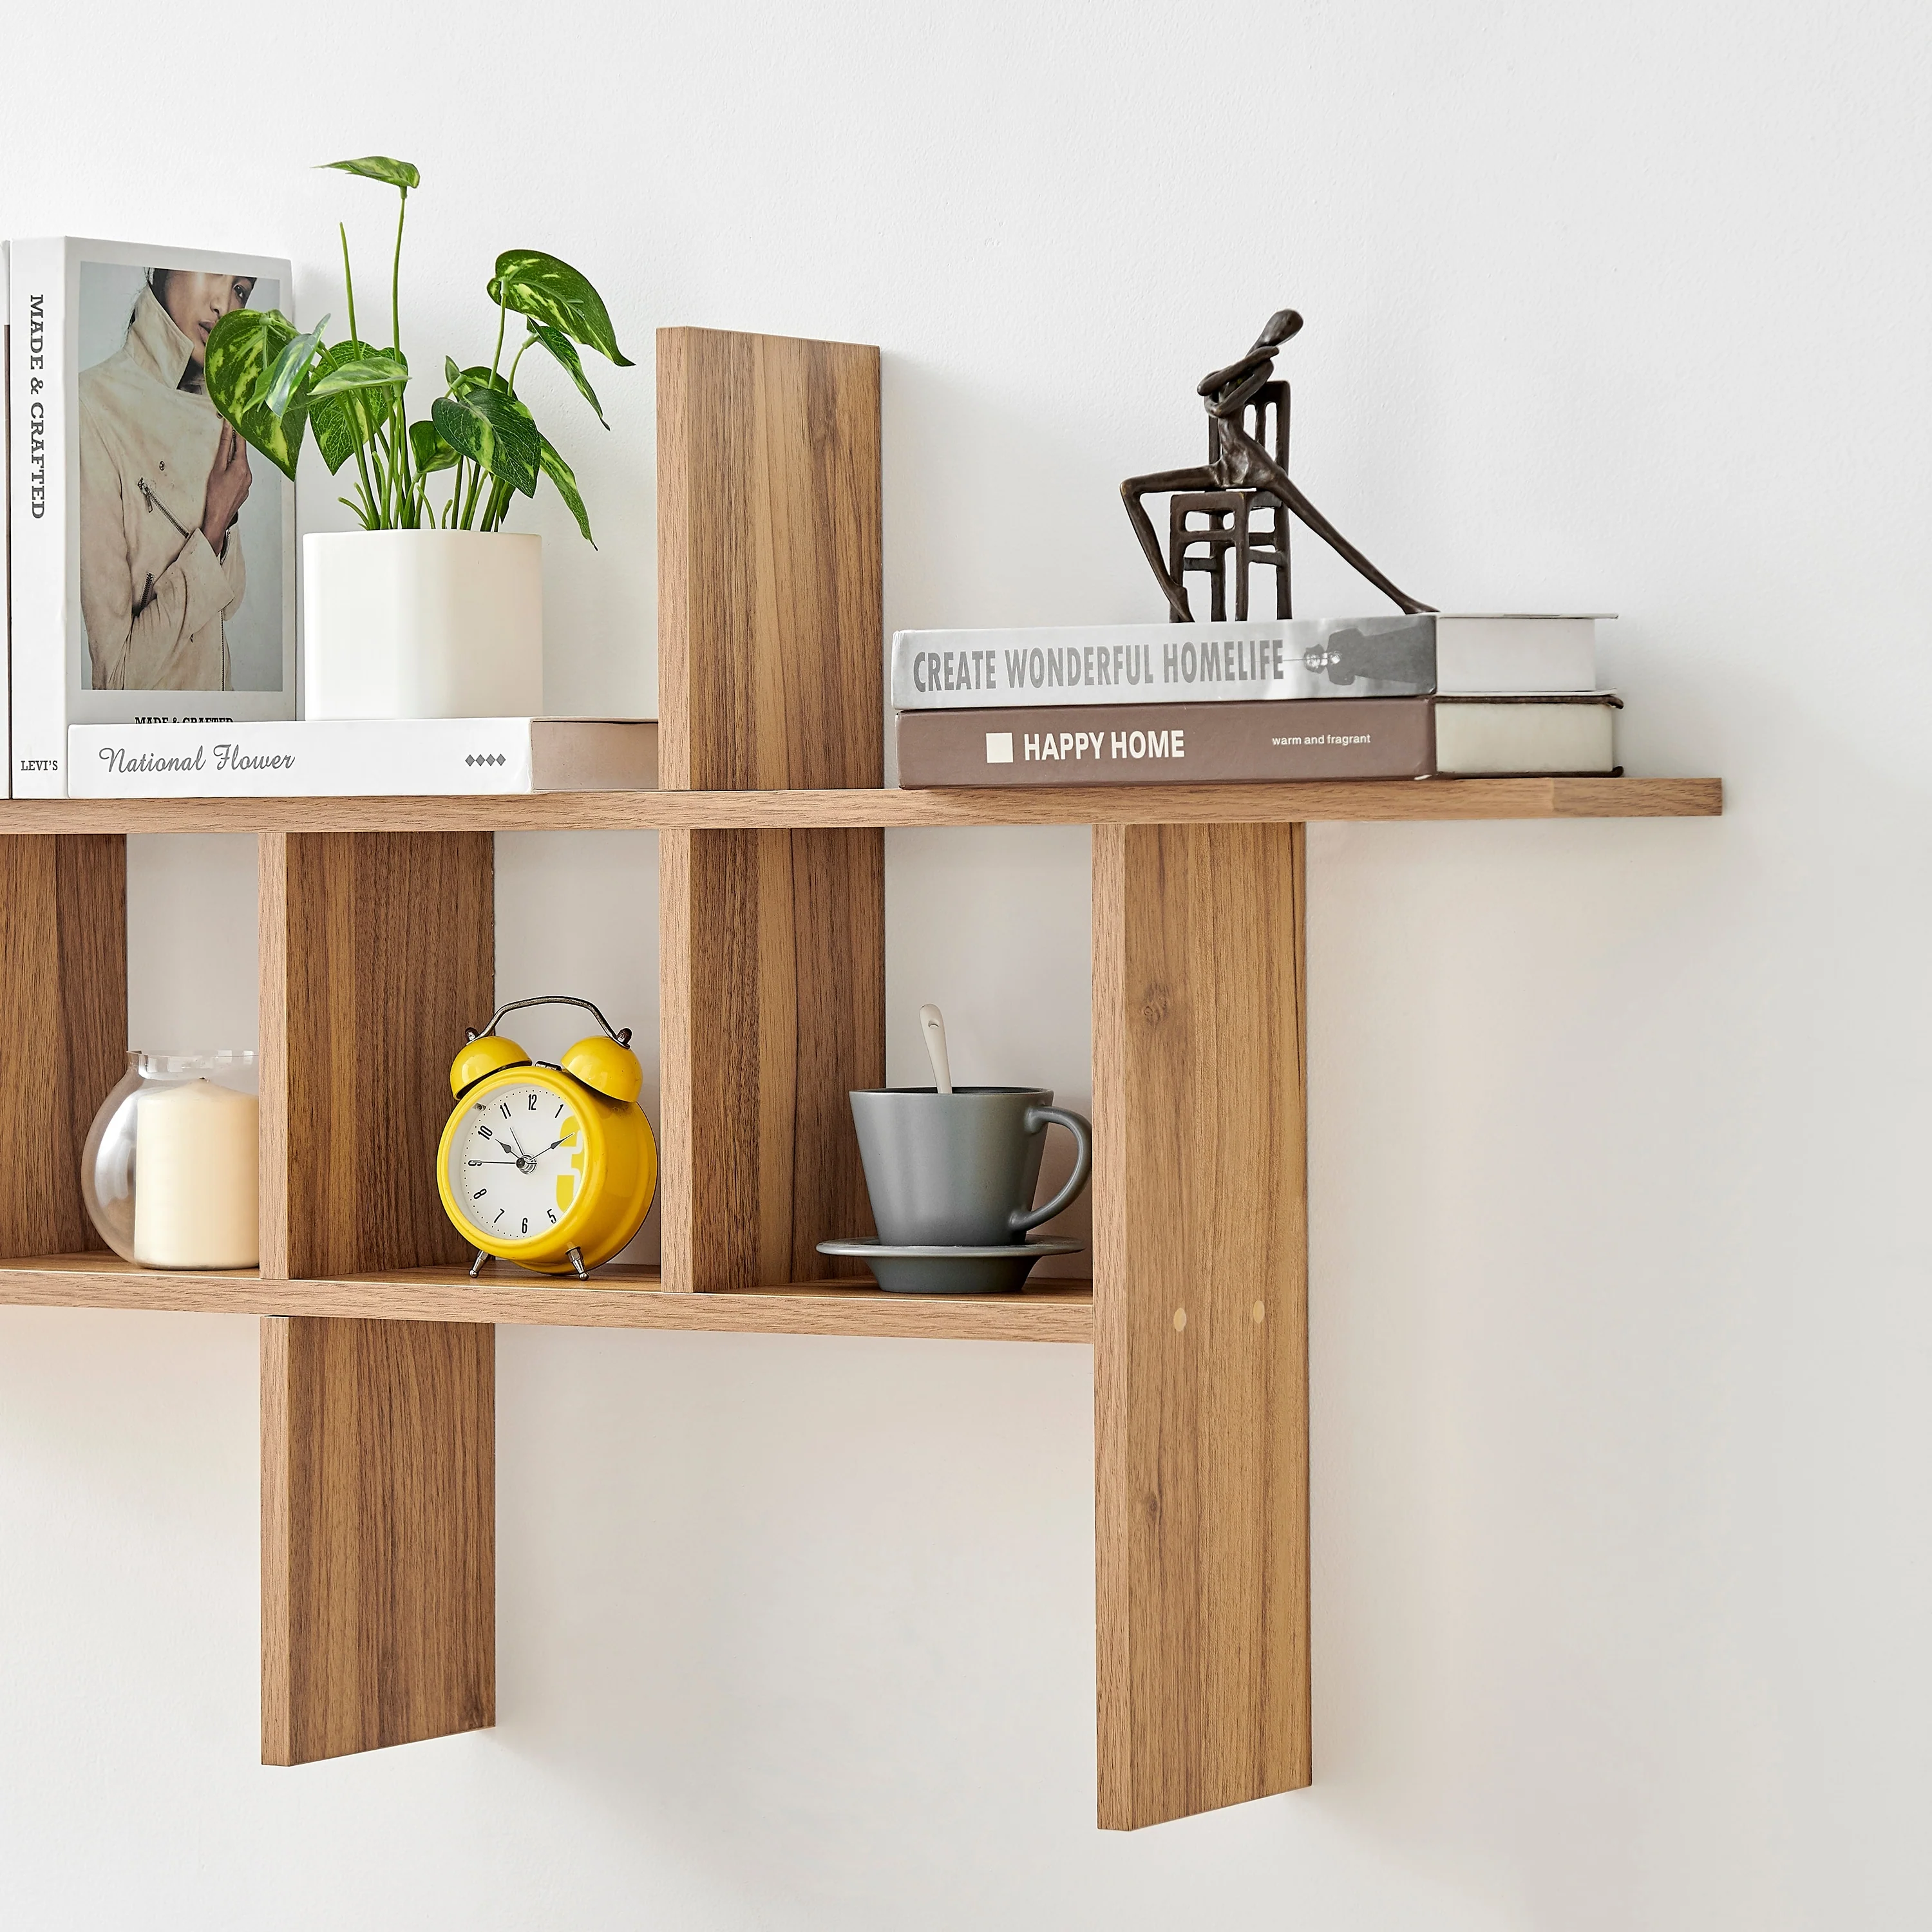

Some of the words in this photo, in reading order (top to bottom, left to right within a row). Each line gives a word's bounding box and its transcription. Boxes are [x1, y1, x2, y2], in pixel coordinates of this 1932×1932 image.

[30, 294, 44, 370] MADE
[30, 377, 44, 395] &
[30, 402, 45, 519] CRAFTED
[913, 650, 996, 693] CREATE
[1005, 645, 1153, 688] WONDERFUL
[1164, 639, 1283, 683] HOMELIFE
[1024, 732, 1104, 761] HAPPY
[1111, 730, 1185, 759] HOME
[1272, 737, 1302, 745] warm
[1304, 734, 1325, 745] and
[1327, 734, 1371, 746] fragrant
[21, 760, 58, 771] LEVI'S
[99, 744, 207, 773] National
[213, 744, 296, 771] Flower
[499, 1102, 511, 1119] 11
[528, 1094, 537, 1111] 12
[554, 1104, 564, 1119] 1
[477, 1125, 493, 1141] 10
[473, 1188, 488, 1200] 8
[493, 1208, 505, 1224] 7
[547, 1208, 557, 1224] 5
[521, 1217, 528, 1234] 6
